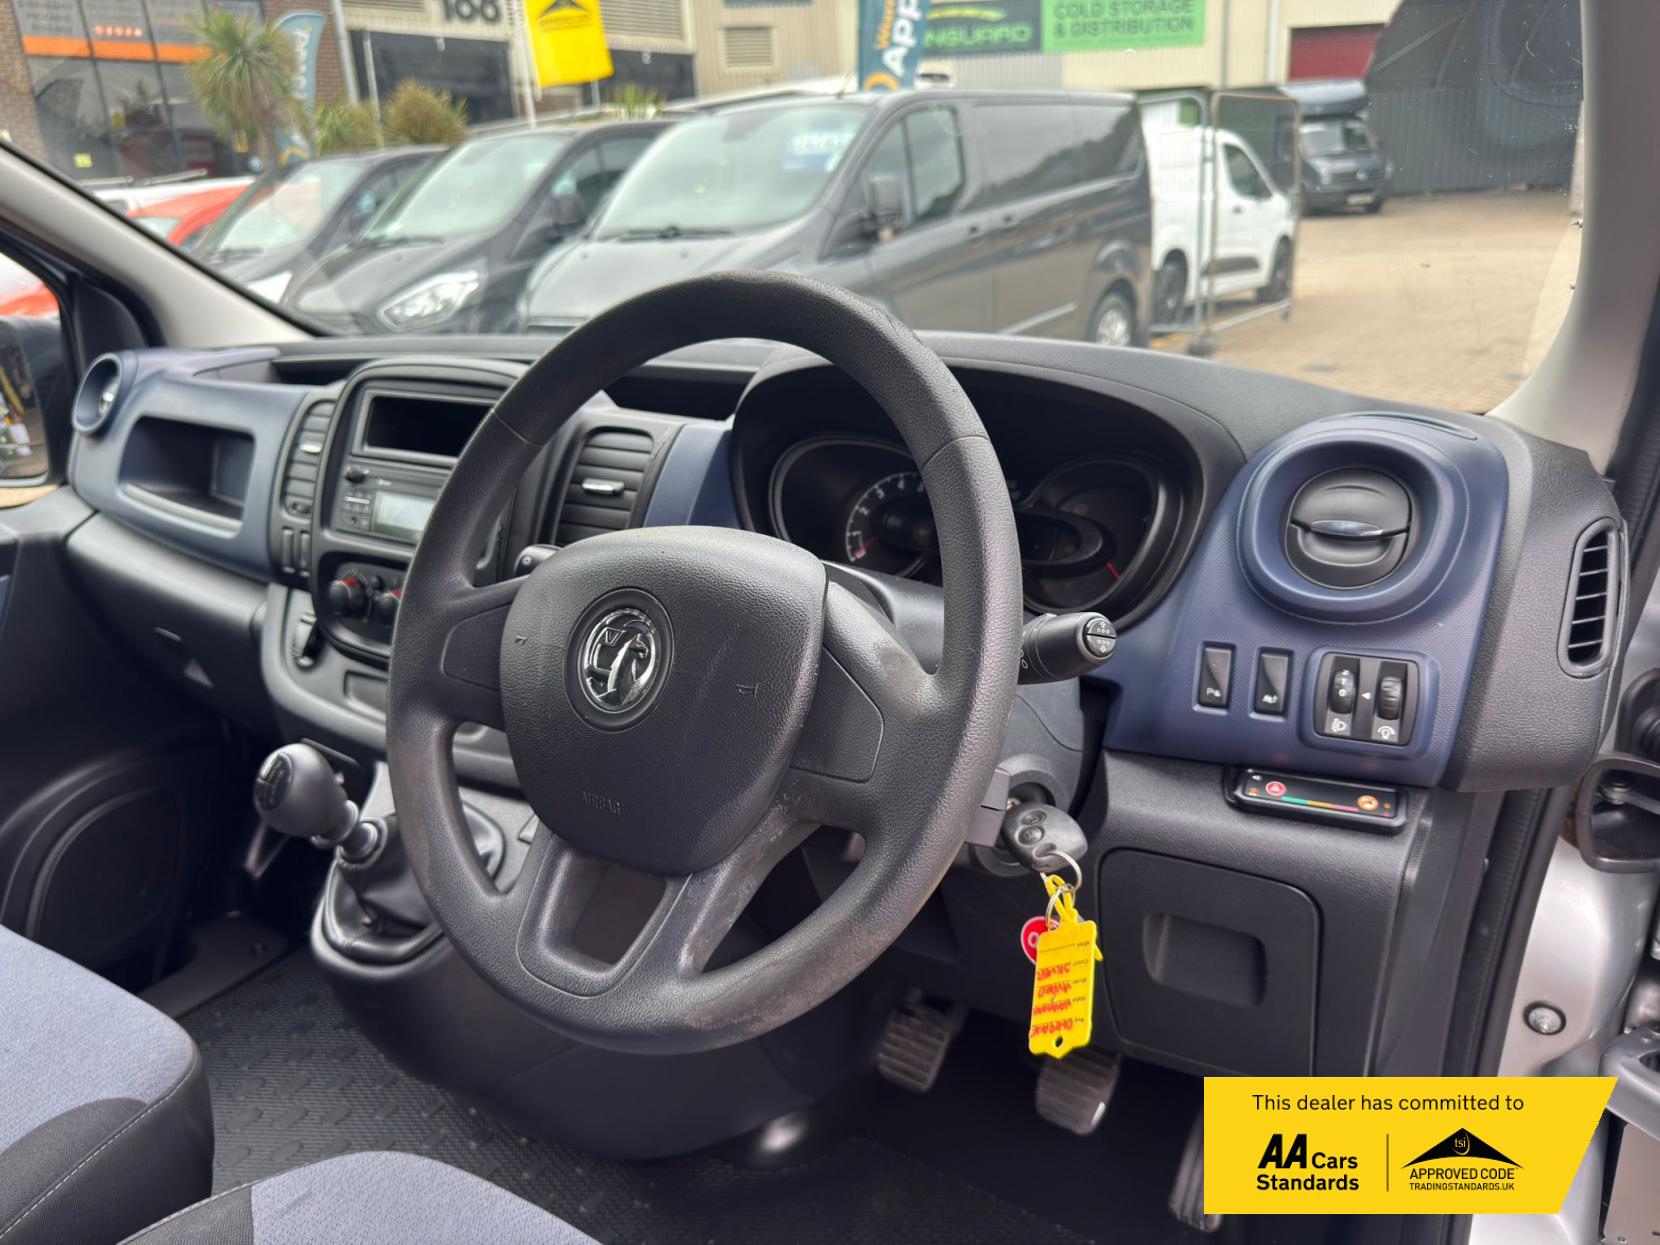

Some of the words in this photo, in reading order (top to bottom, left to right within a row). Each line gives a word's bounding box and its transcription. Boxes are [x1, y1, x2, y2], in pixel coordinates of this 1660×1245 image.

[1054, 1, 1106, 20] COLD
[1107, 0, 1195, 17] STORAGE
[1053, 21, 1066, 38] &
[1069, 16, 1195, 37] DISTRIBUTION
